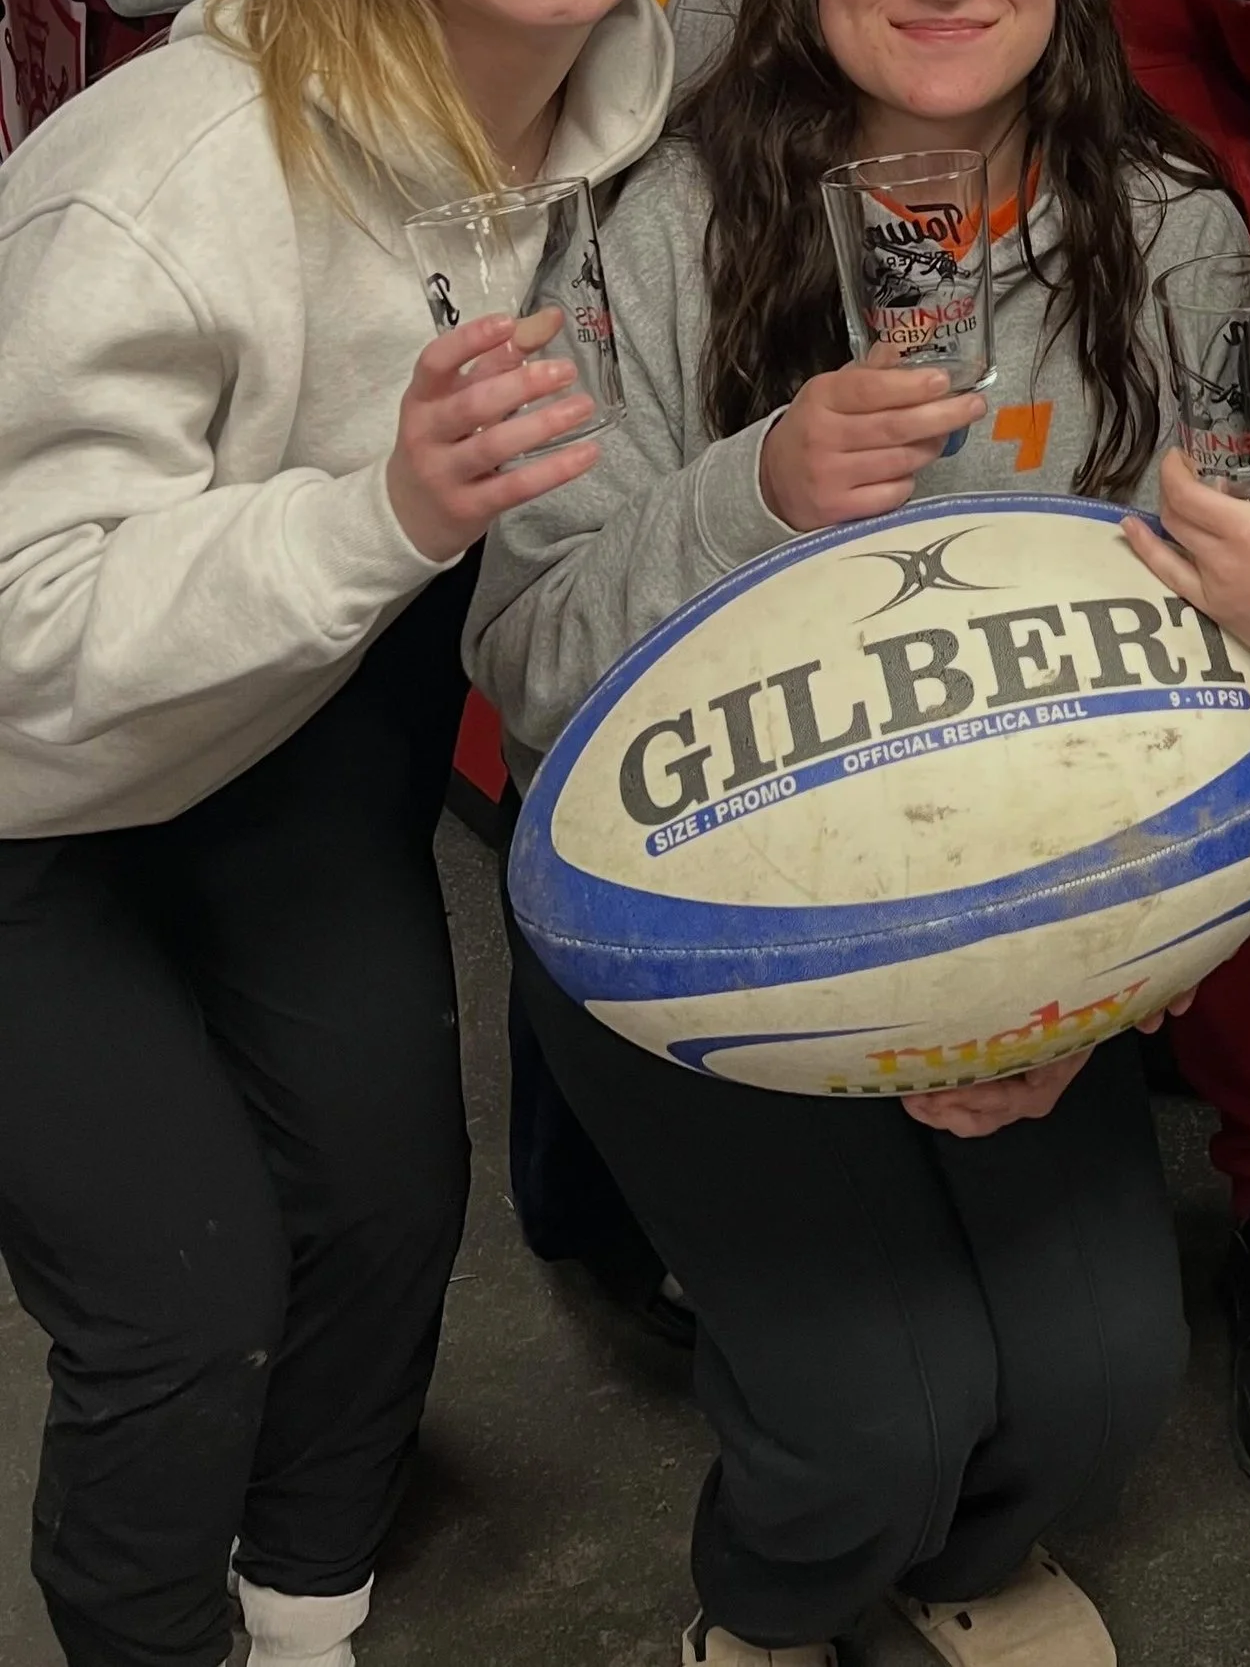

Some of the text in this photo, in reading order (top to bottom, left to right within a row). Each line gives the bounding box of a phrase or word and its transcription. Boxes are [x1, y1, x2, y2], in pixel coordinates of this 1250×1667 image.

[864, 296, 976, 329] VIKINGS
[934, 316, 978, 340] CLUB
[619, 596, 1246, 826] GILBERT
[654, 812, 700, 852] SIZE
[715, 775, 797, 824] PROMO
[843, 732, 939, 773] OFFICIAL
[943, 712, 1031, 745] REPLICA
[1036, 700, 1088, 724] BALL
[1169, 690, 1180, 708] 9
[1196, 689, 1214, 706] 10
[1218, 689, 1245, 708] PSI
